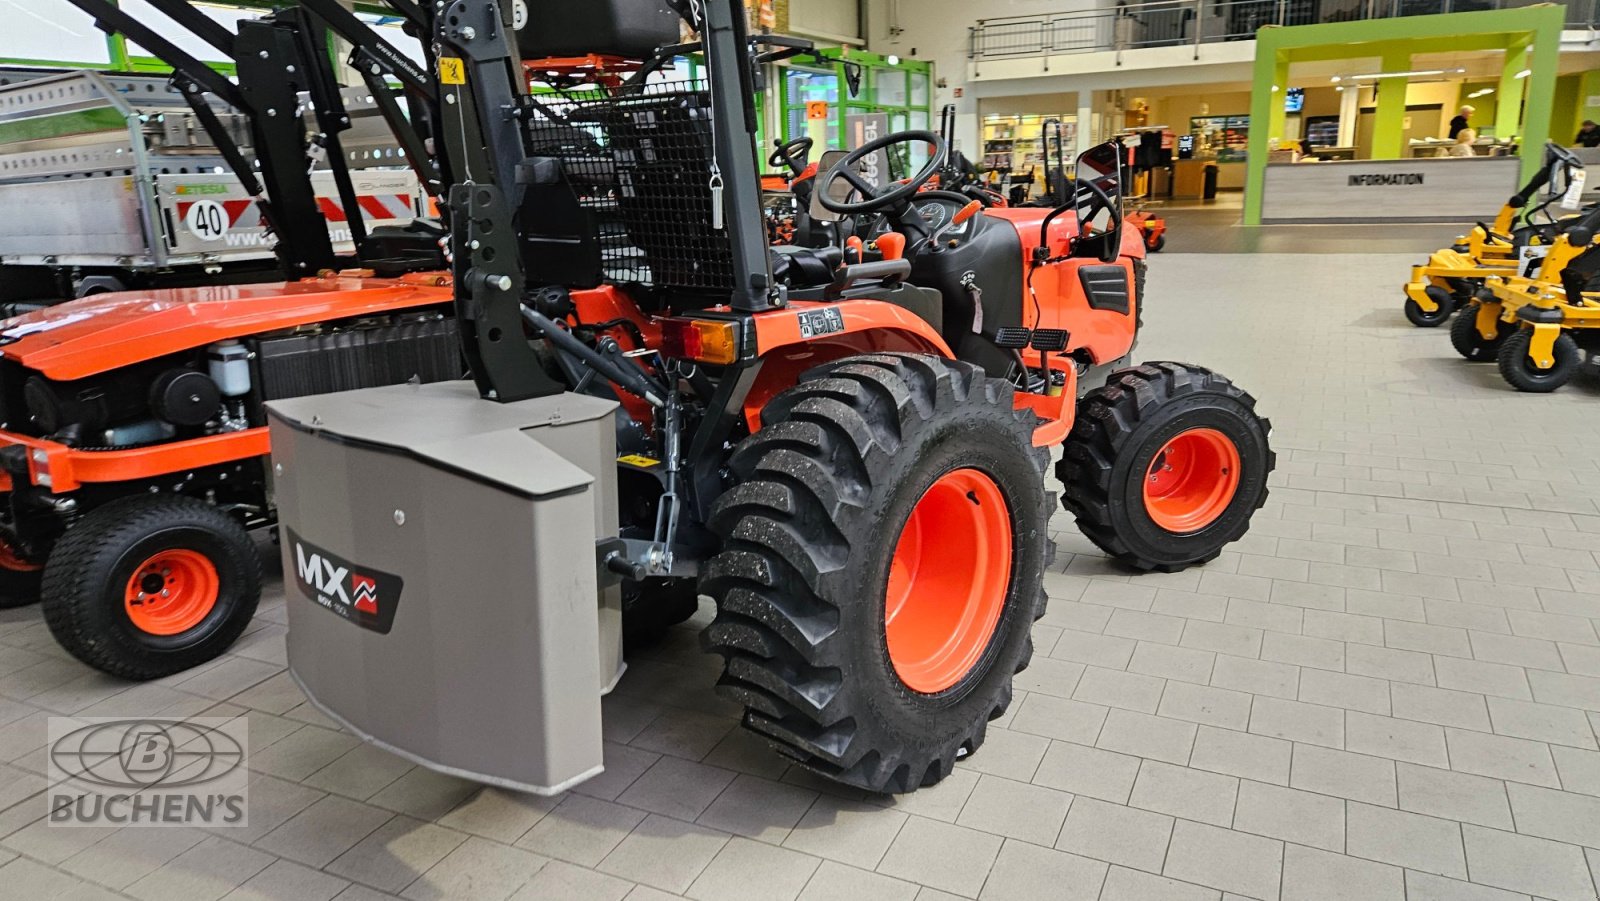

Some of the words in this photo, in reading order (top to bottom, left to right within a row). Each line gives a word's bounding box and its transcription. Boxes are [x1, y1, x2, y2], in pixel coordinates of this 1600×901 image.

[376, 42, 427, 84] www.buchens.de
[1347, 173, 1424, 186] INFORMATION
[196, 204, 221, 236] 40
[296, 542, 351, 606] MX
